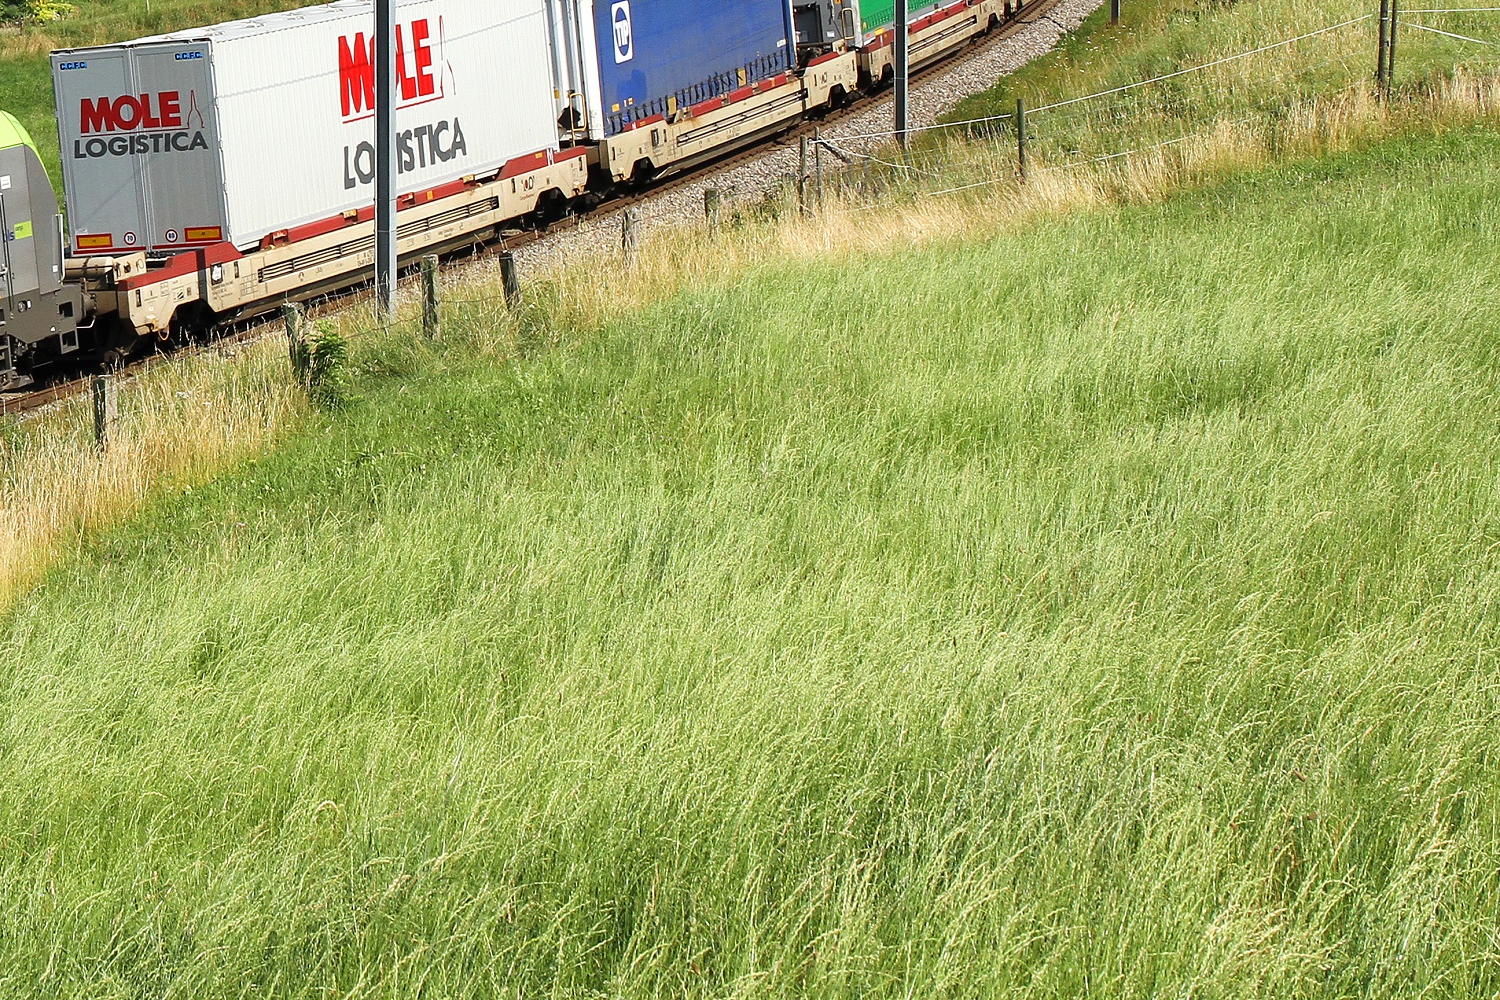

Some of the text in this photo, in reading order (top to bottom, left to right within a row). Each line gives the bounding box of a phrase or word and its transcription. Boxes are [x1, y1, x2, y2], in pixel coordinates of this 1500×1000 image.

[615, 18, 630, 48] TIP
[174, 51, 203, 61] C.C.F.C.
[338, 18, 435, 117] MLE
[80, 91, 182, 134] MOLE
[74, 131, 209, 159] LOGISTICA
[343, 117, 467, 190] LOISTICA
